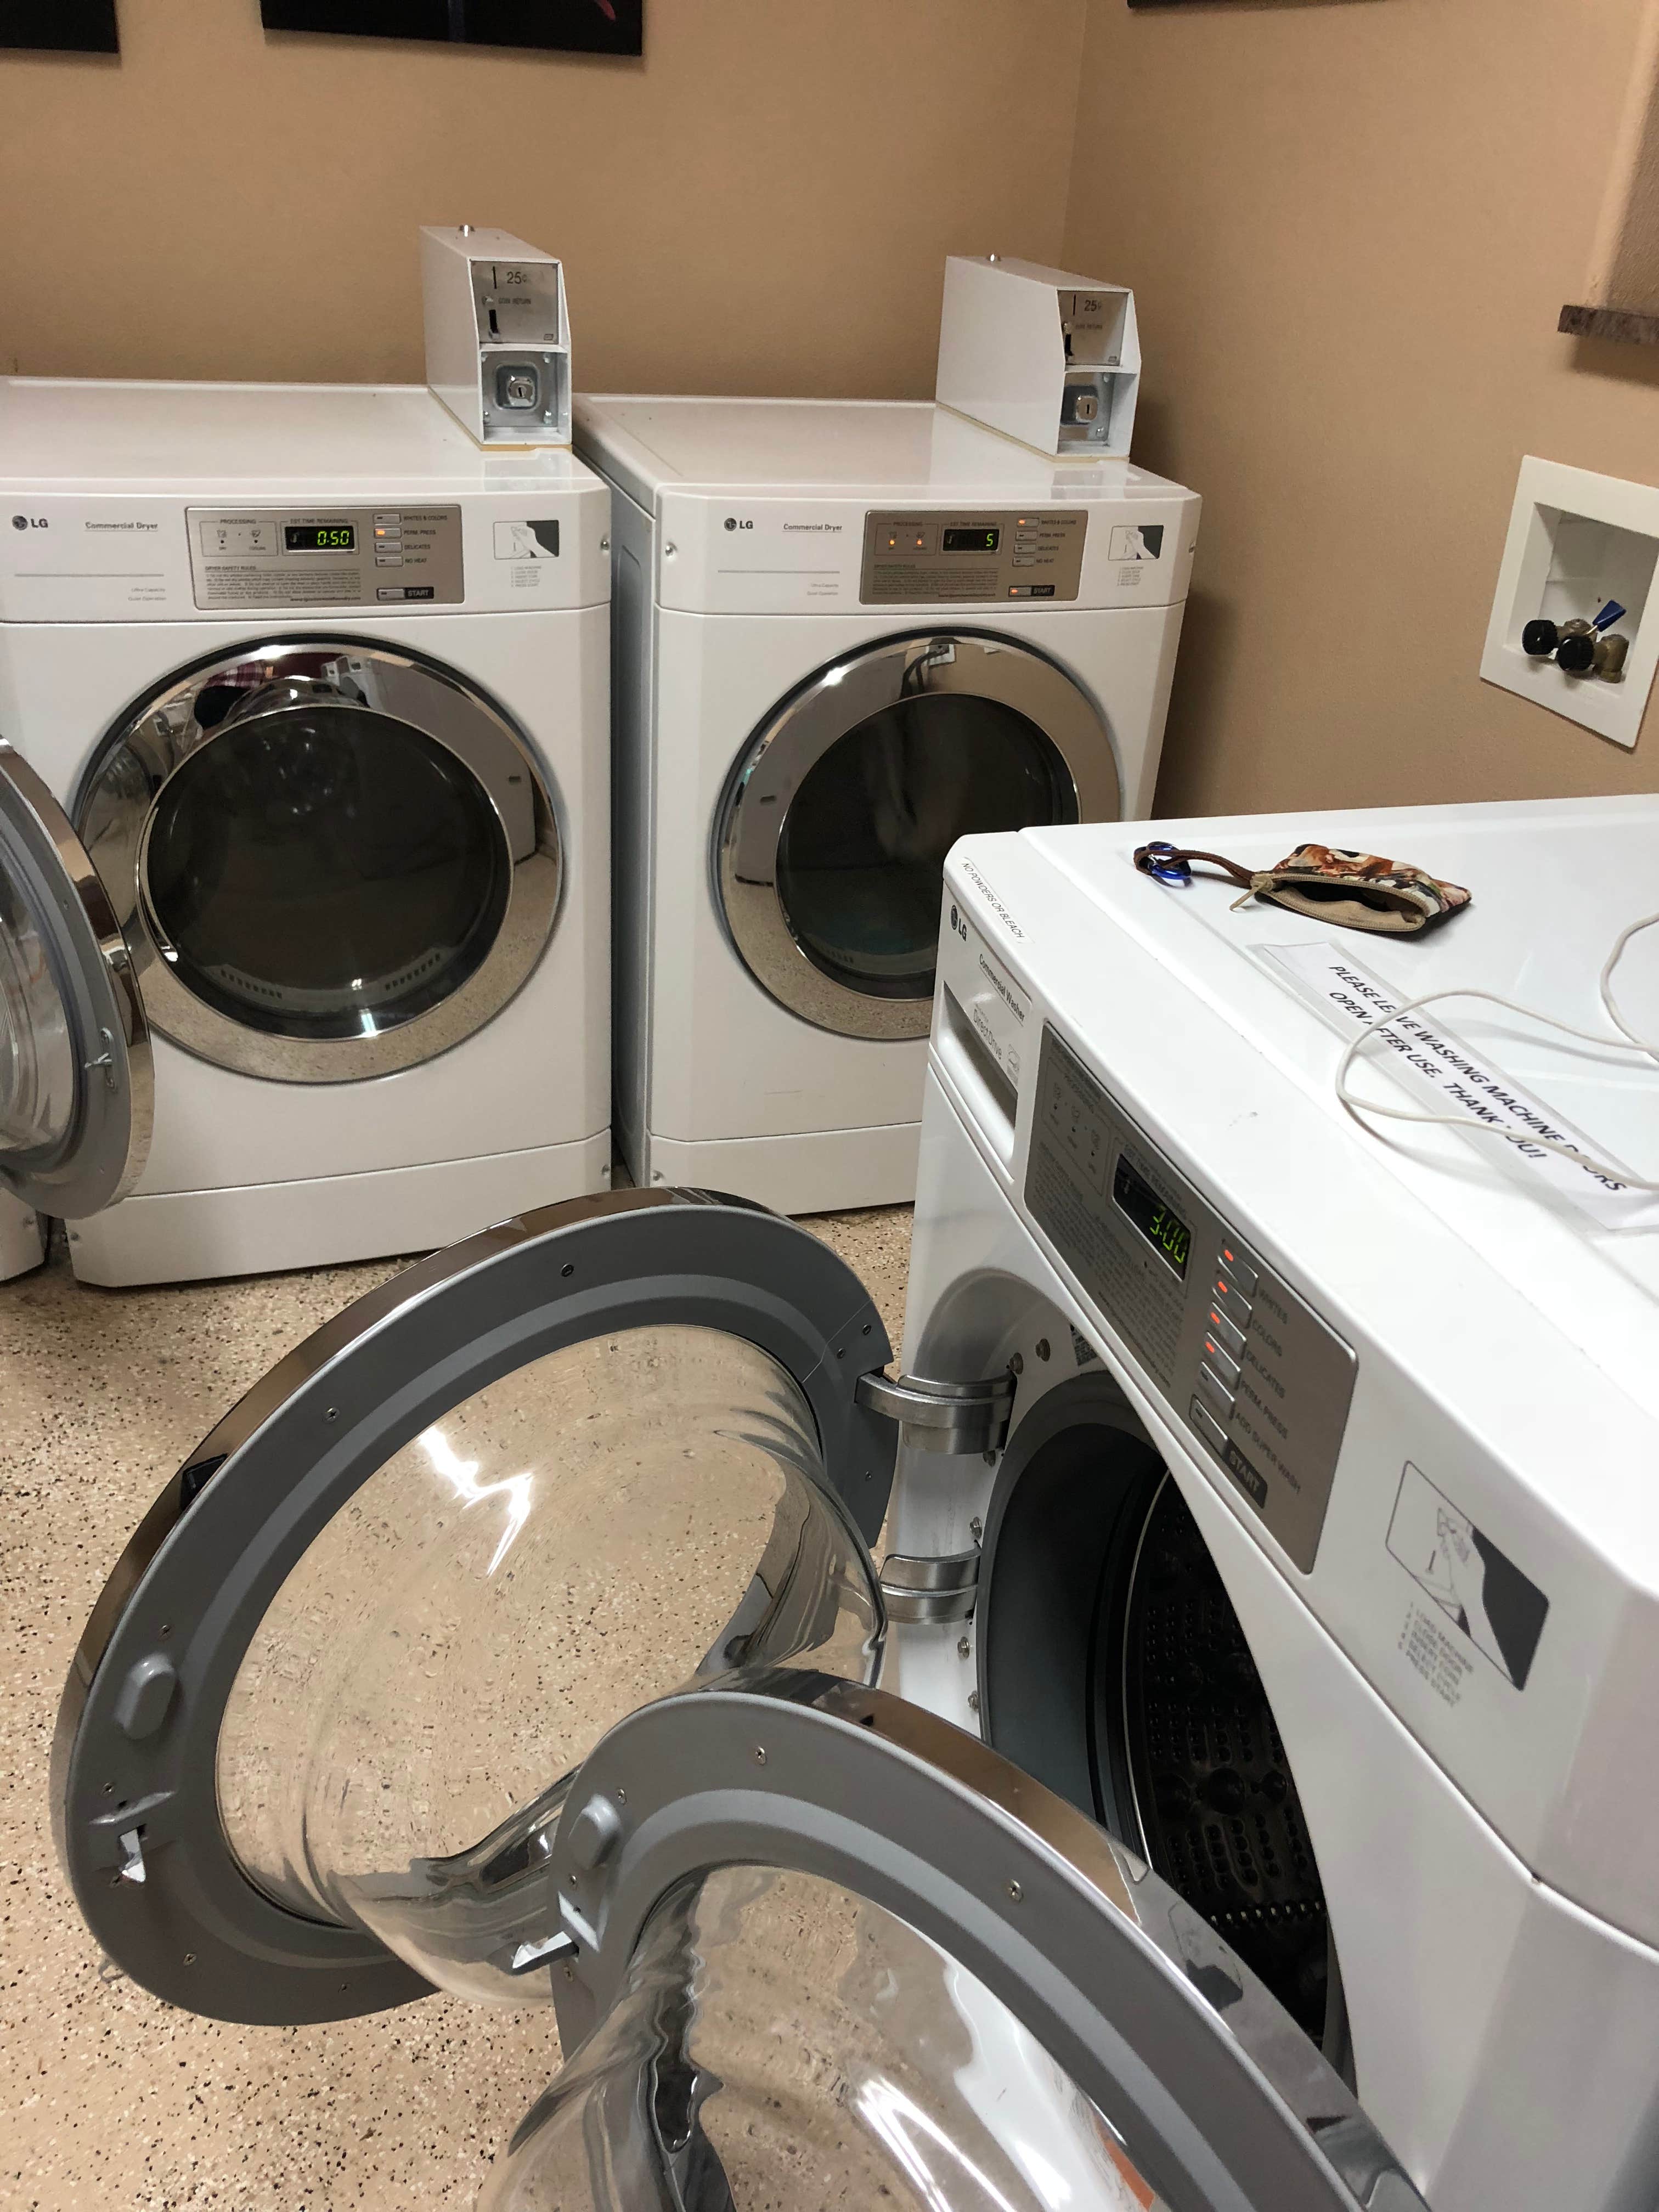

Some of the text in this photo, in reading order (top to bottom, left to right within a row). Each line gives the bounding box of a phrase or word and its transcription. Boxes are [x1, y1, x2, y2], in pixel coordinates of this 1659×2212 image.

[30, 518, 49, 528] LG
[136, 522, 158, 531] Dryer
[739, 520, 753, 529] LG
[986, 533, 994, 546] 5
[962, 862, 1025, 938] NO POWDERS OR BLEACH
[979, 953, 1006, 997] Commercial
[1006, 989, 1025, 1022] Washer
[1329, 966, 1381, 998] PLEASE
[1372, 1000, 1423, 1030] LEVE
[1414, 1031, 1490, 1084] WASHING
[1482, 1085, 1566, 1141] MACHINE
[1329, 992, 1373, 1019] OPEN
[1406, 1054, 1443, 1078] USE.
[1443, 1082, 1505, 1123] THANK
[1505, 1125, 1548, 1158] OU!
[1252, 1318, 1282, 1357] COLORS
[1246, 1350, 1286, 1399] DELICATES
[1263, 1406, 1288, 1440] PRESS
[1229, 1450, 1260, 1492] START
[1278, 1460, 1301, 1494] WASH
